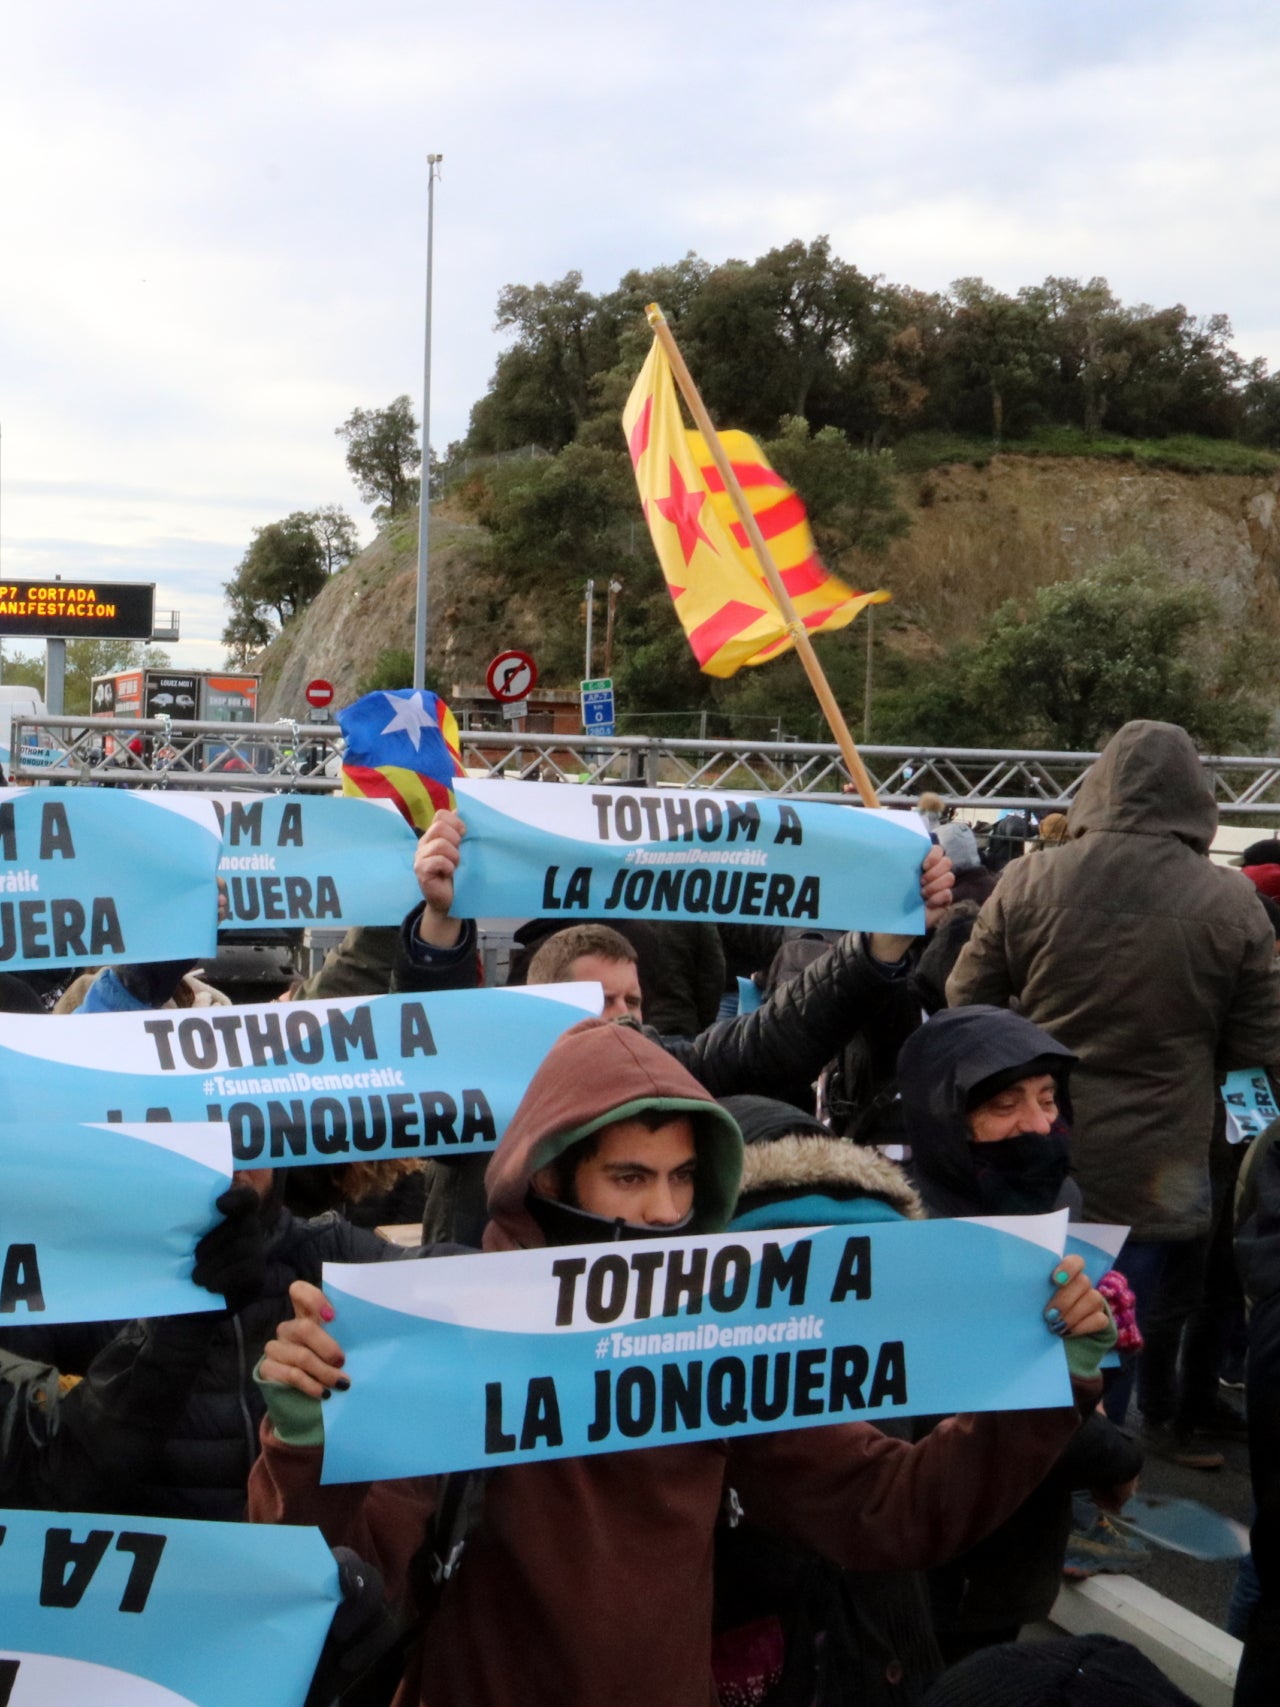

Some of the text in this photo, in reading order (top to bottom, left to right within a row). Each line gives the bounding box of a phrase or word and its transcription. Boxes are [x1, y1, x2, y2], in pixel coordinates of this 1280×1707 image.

[28, 588, 96, 602] CORTADA
[588, 693, 608, 701] AP-7
[595, 712, 604, 722] 0
[39, 802, 76, 860] A
[277, 802, 304, 847] A
[592, 793, 803, 846] TOTHOM A
[542, 866, 820, 919] LA JONQUERA
[144, 1002, 438, 1070] TOTHOM A
[203, 1065, 405, 1097] #TsunamiDemocràtic
[207, 1088, 497, 1160] ONQUERA
[552, 1235, 872, 1327] TOTHOM A
[594, 1314, 824, 1360] #TsunamiDemocràtic
[484, 1340, 908, 1455] LA JONQUERA
[39, 1527, 167, 1614] LA
